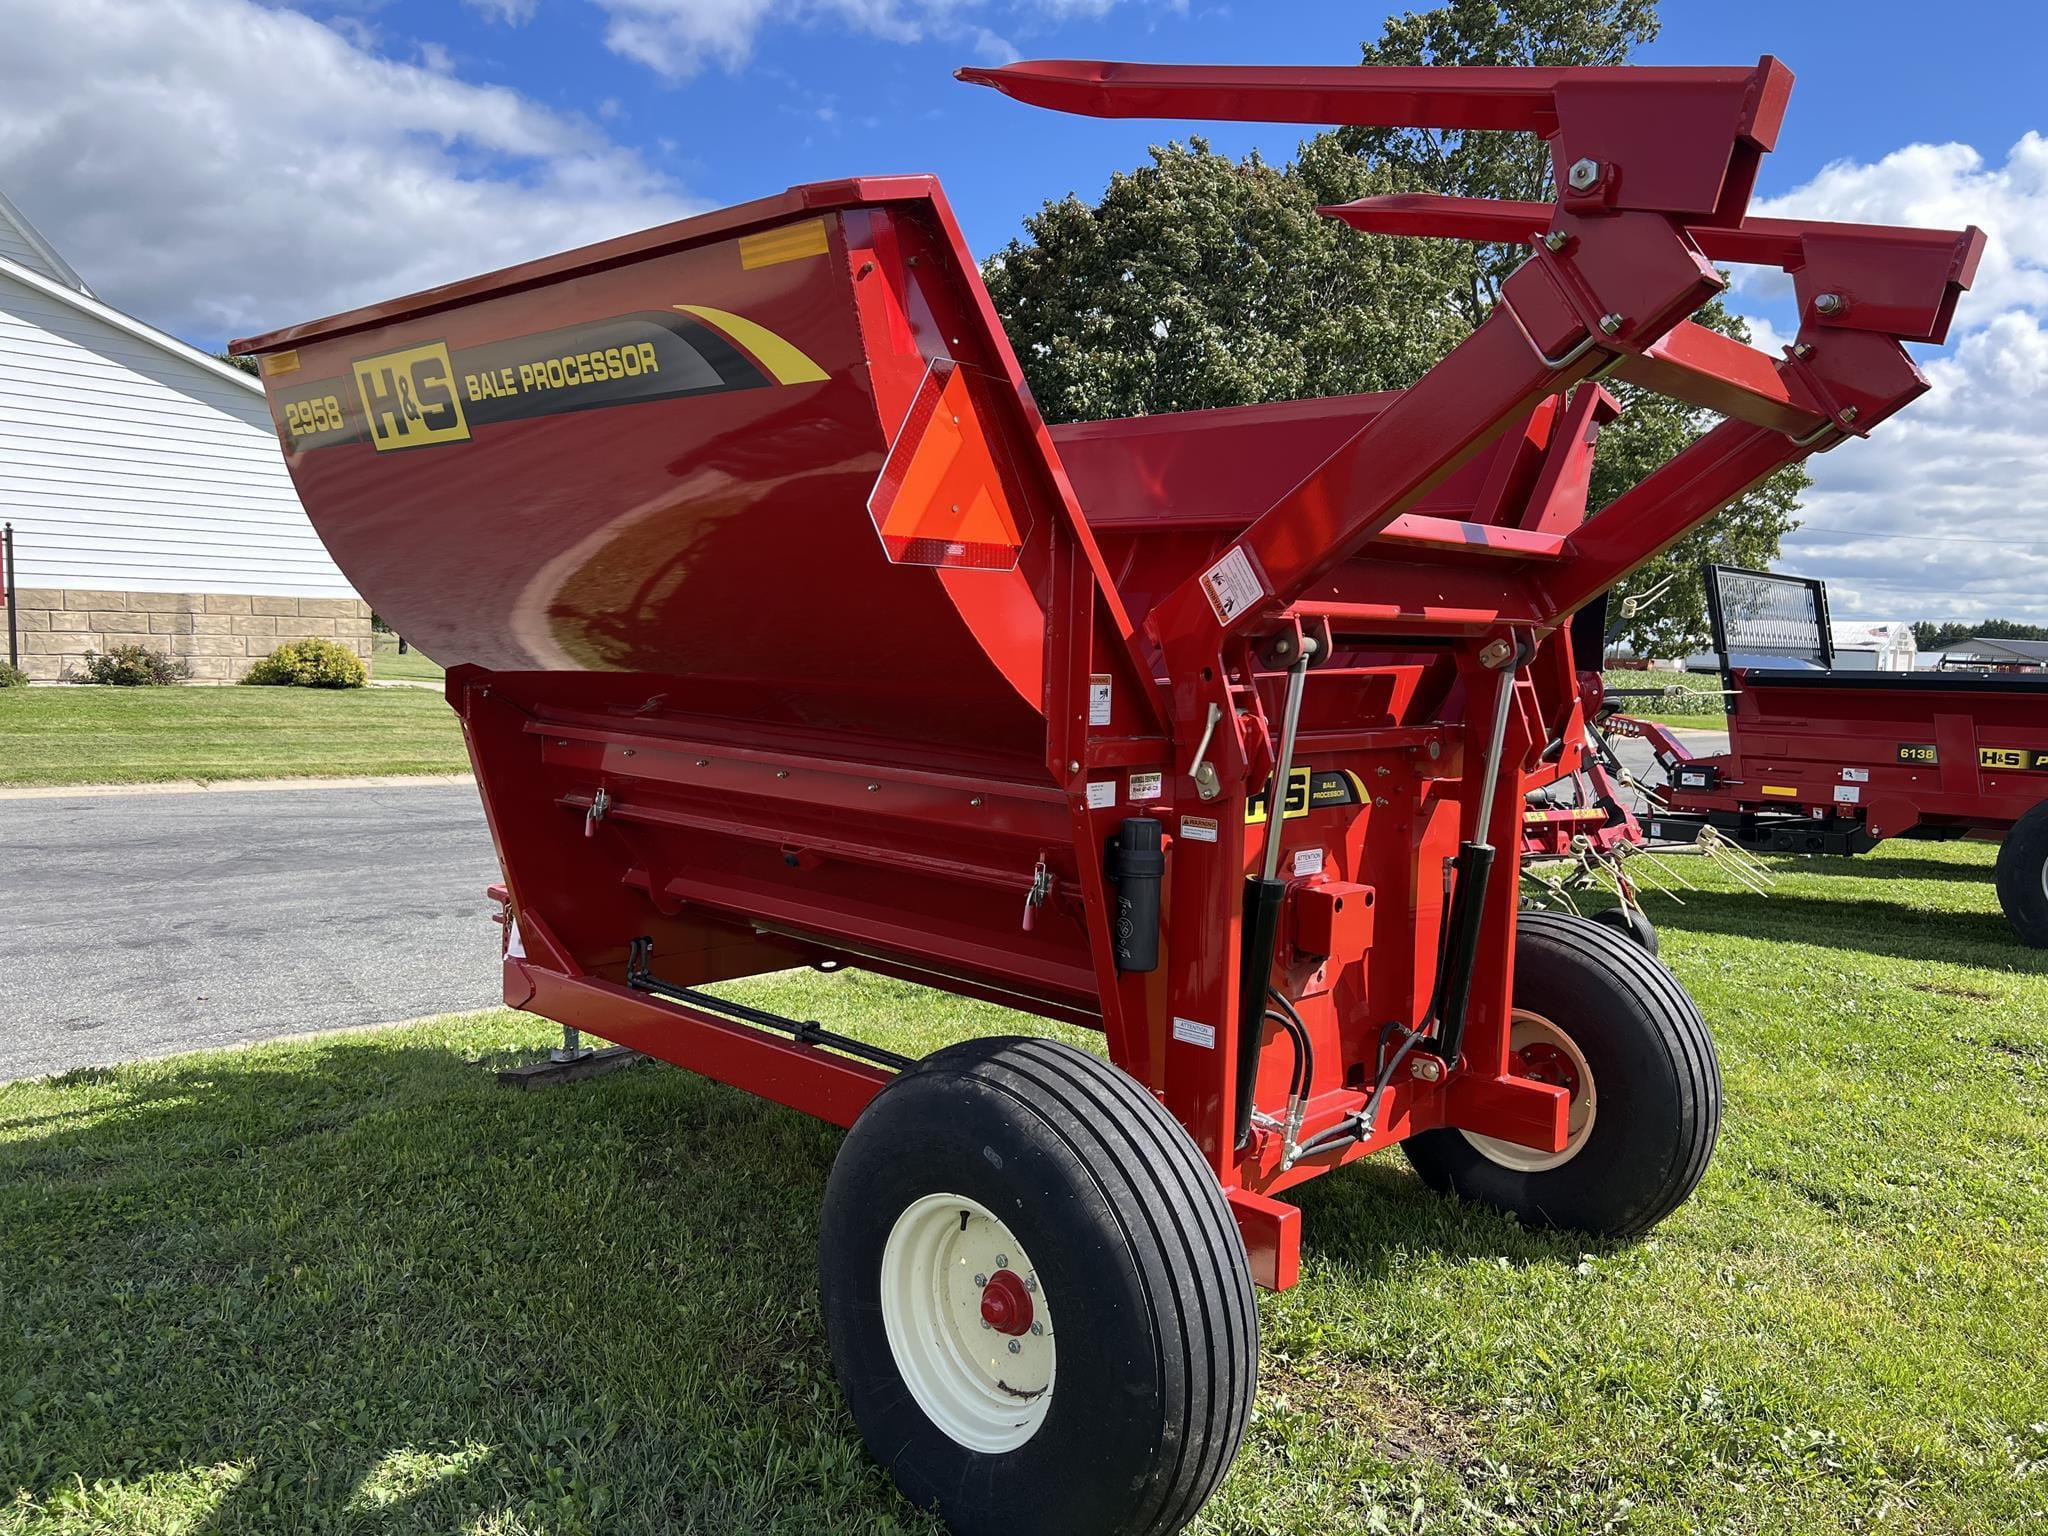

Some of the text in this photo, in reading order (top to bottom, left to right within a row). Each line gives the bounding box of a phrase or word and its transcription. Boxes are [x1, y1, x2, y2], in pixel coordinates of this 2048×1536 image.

[286, 342, 660, 441] 2958 H&S BALE PROCESSOR
[1900, 748, 1934, 759] 6138
[1981, 751, 2020, 766] H&S
[1322, 781, 1337, 789] BALE
[1313, 790, 1345, 800] PROCESSOR
[1296, 852, 1321, 862] ATTENTION
[1180, 1022, 1208, 1033] ATTENTION
